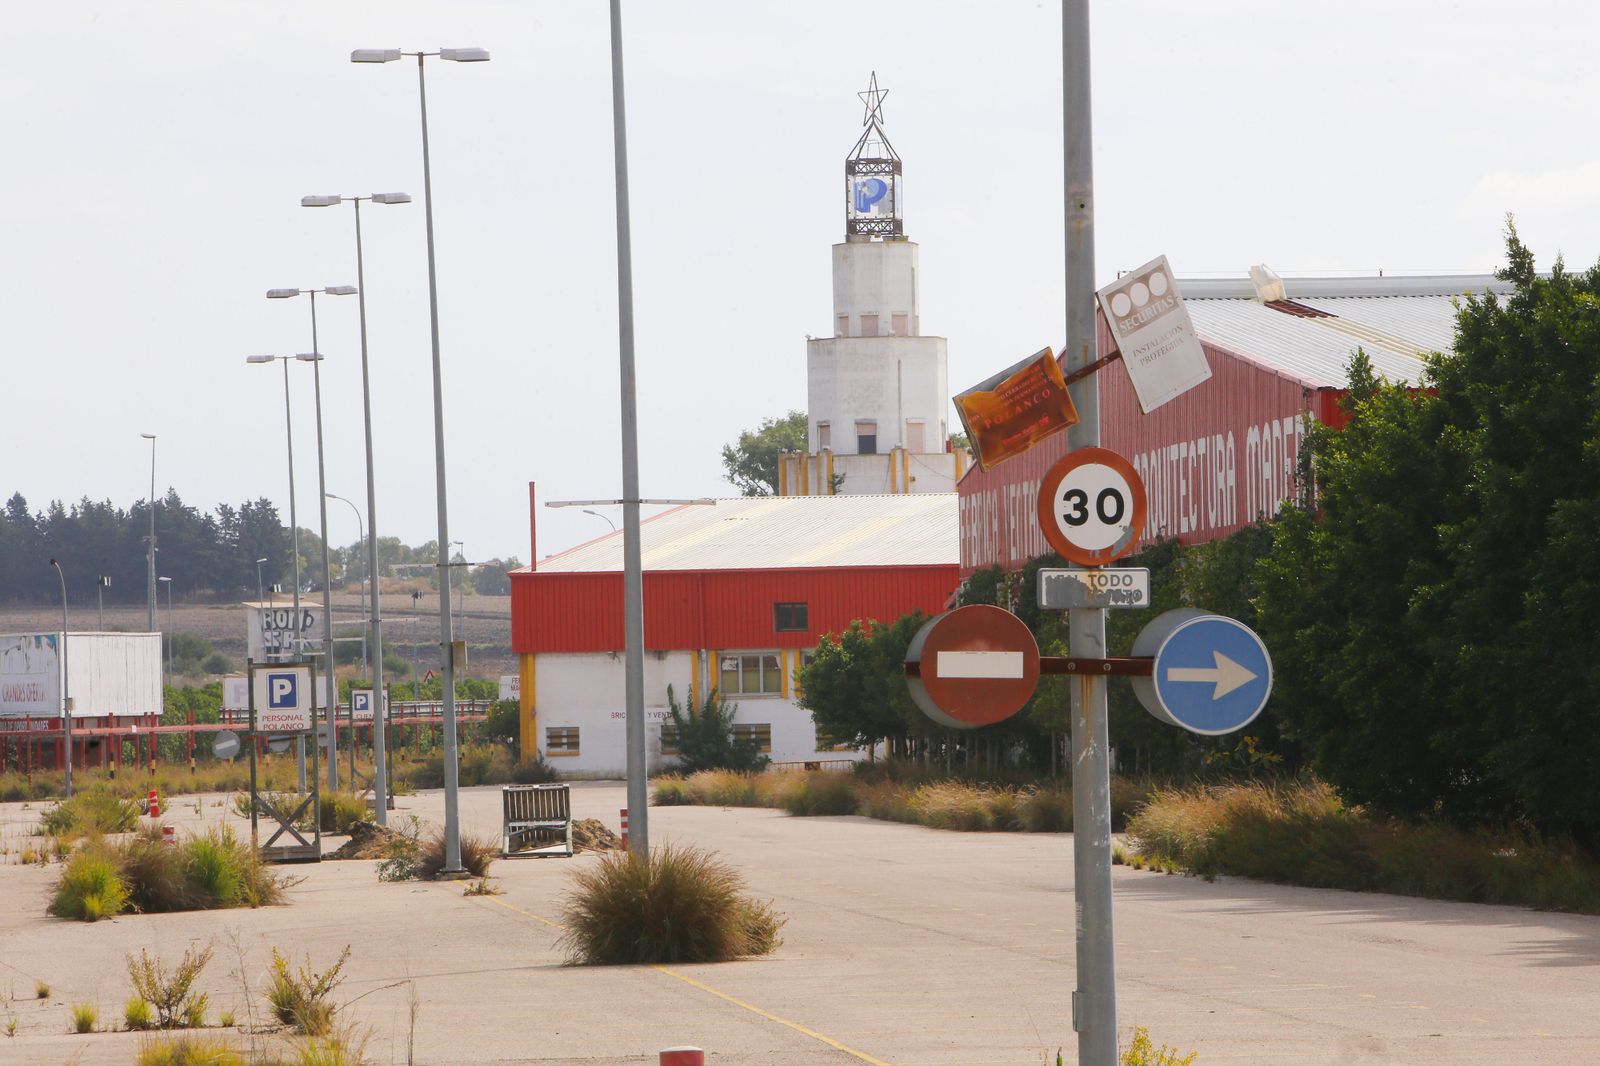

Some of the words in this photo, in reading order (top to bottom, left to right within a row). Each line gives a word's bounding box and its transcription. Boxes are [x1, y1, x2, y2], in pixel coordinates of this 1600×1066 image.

[1119, 295, 1174, 333] SECURITAS
[984, 388, 1051, 429] POLANCO
[1063, 488, 1124, 526] 30
[1088, 574, 1133, 587] TODO
[273, 679, 292, 704] P
